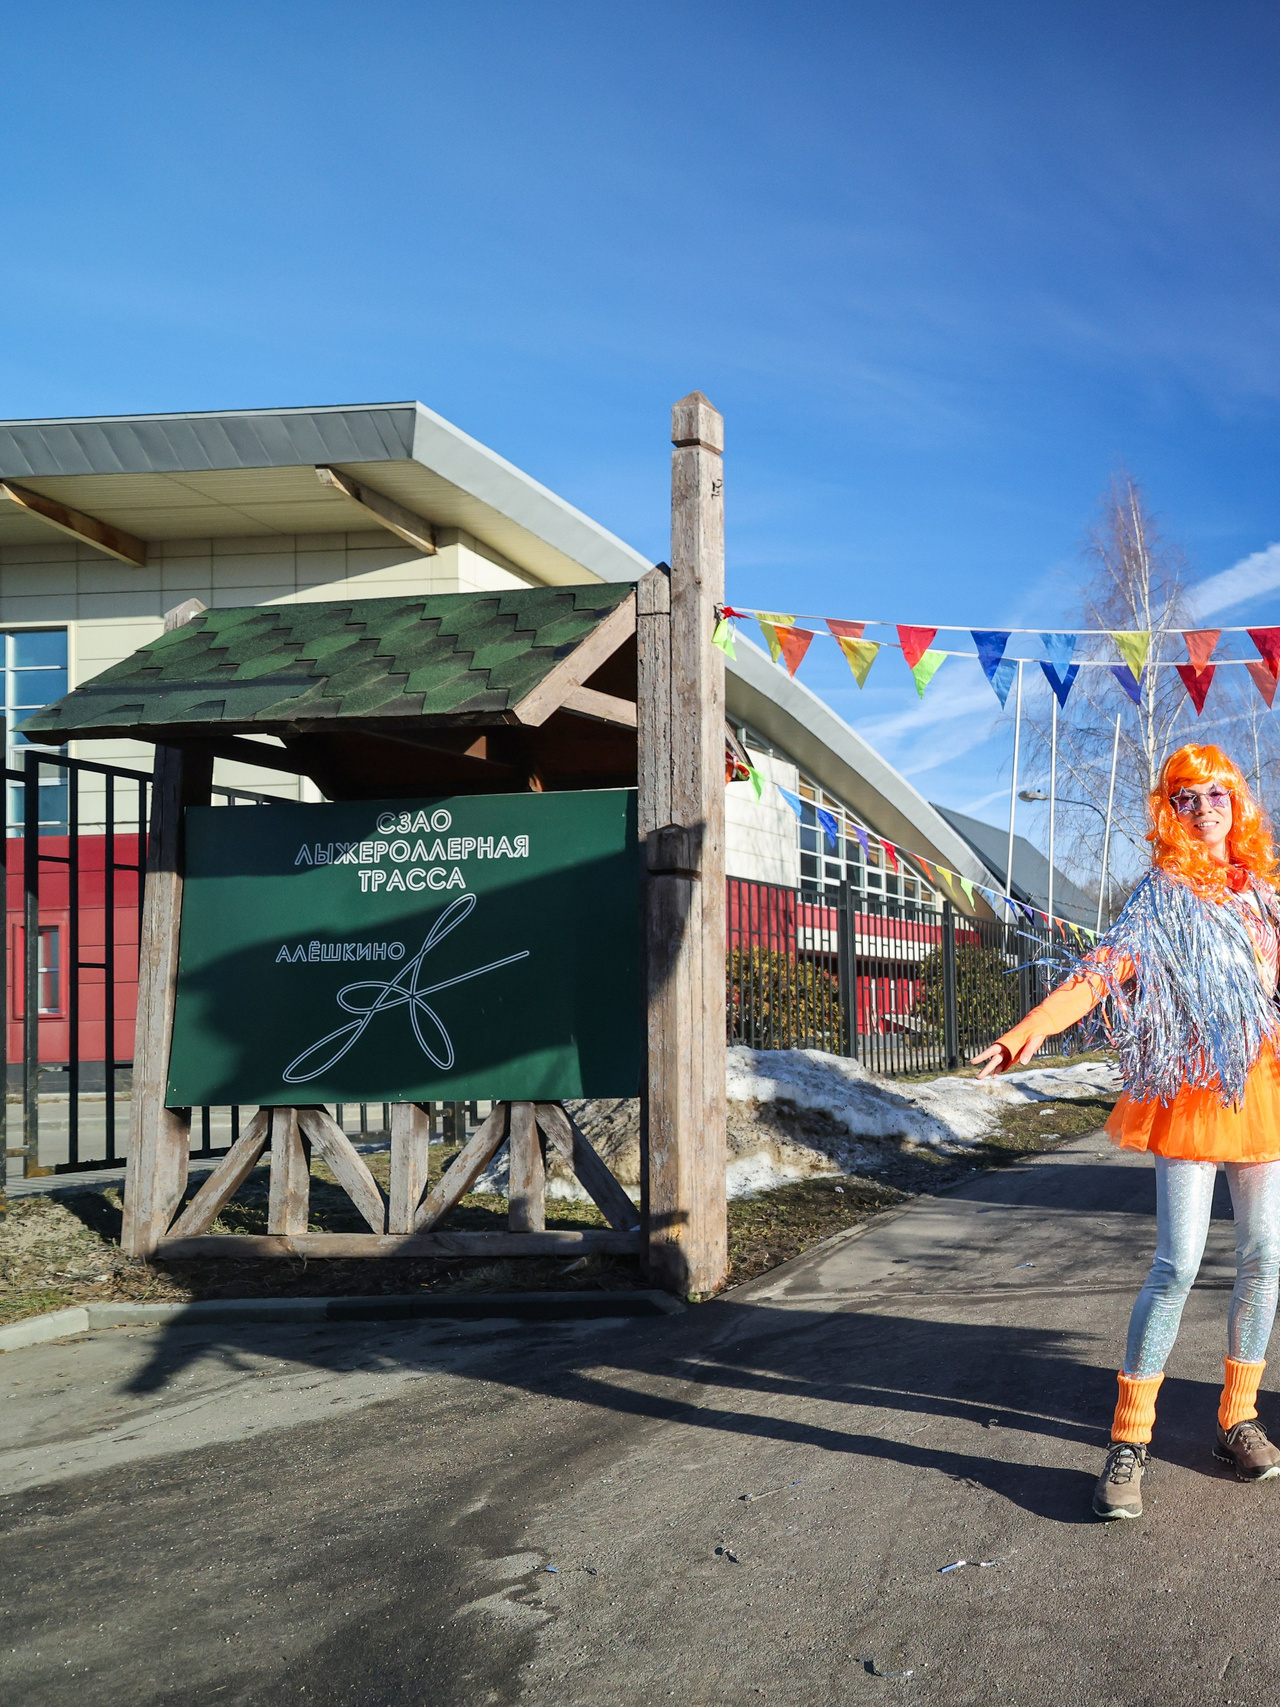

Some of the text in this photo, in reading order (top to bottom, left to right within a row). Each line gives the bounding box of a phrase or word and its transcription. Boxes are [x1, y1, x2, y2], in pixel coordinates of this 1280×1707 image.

[376, 808, 452, 835] СЗАО
[294, 835, 530, 866] ЛЫЖЕРОЛЛЕРНАЯ
[358, 866, 466, 892] ТРАССА
[275, 940, 406, 963] АЛЁШКИНО
